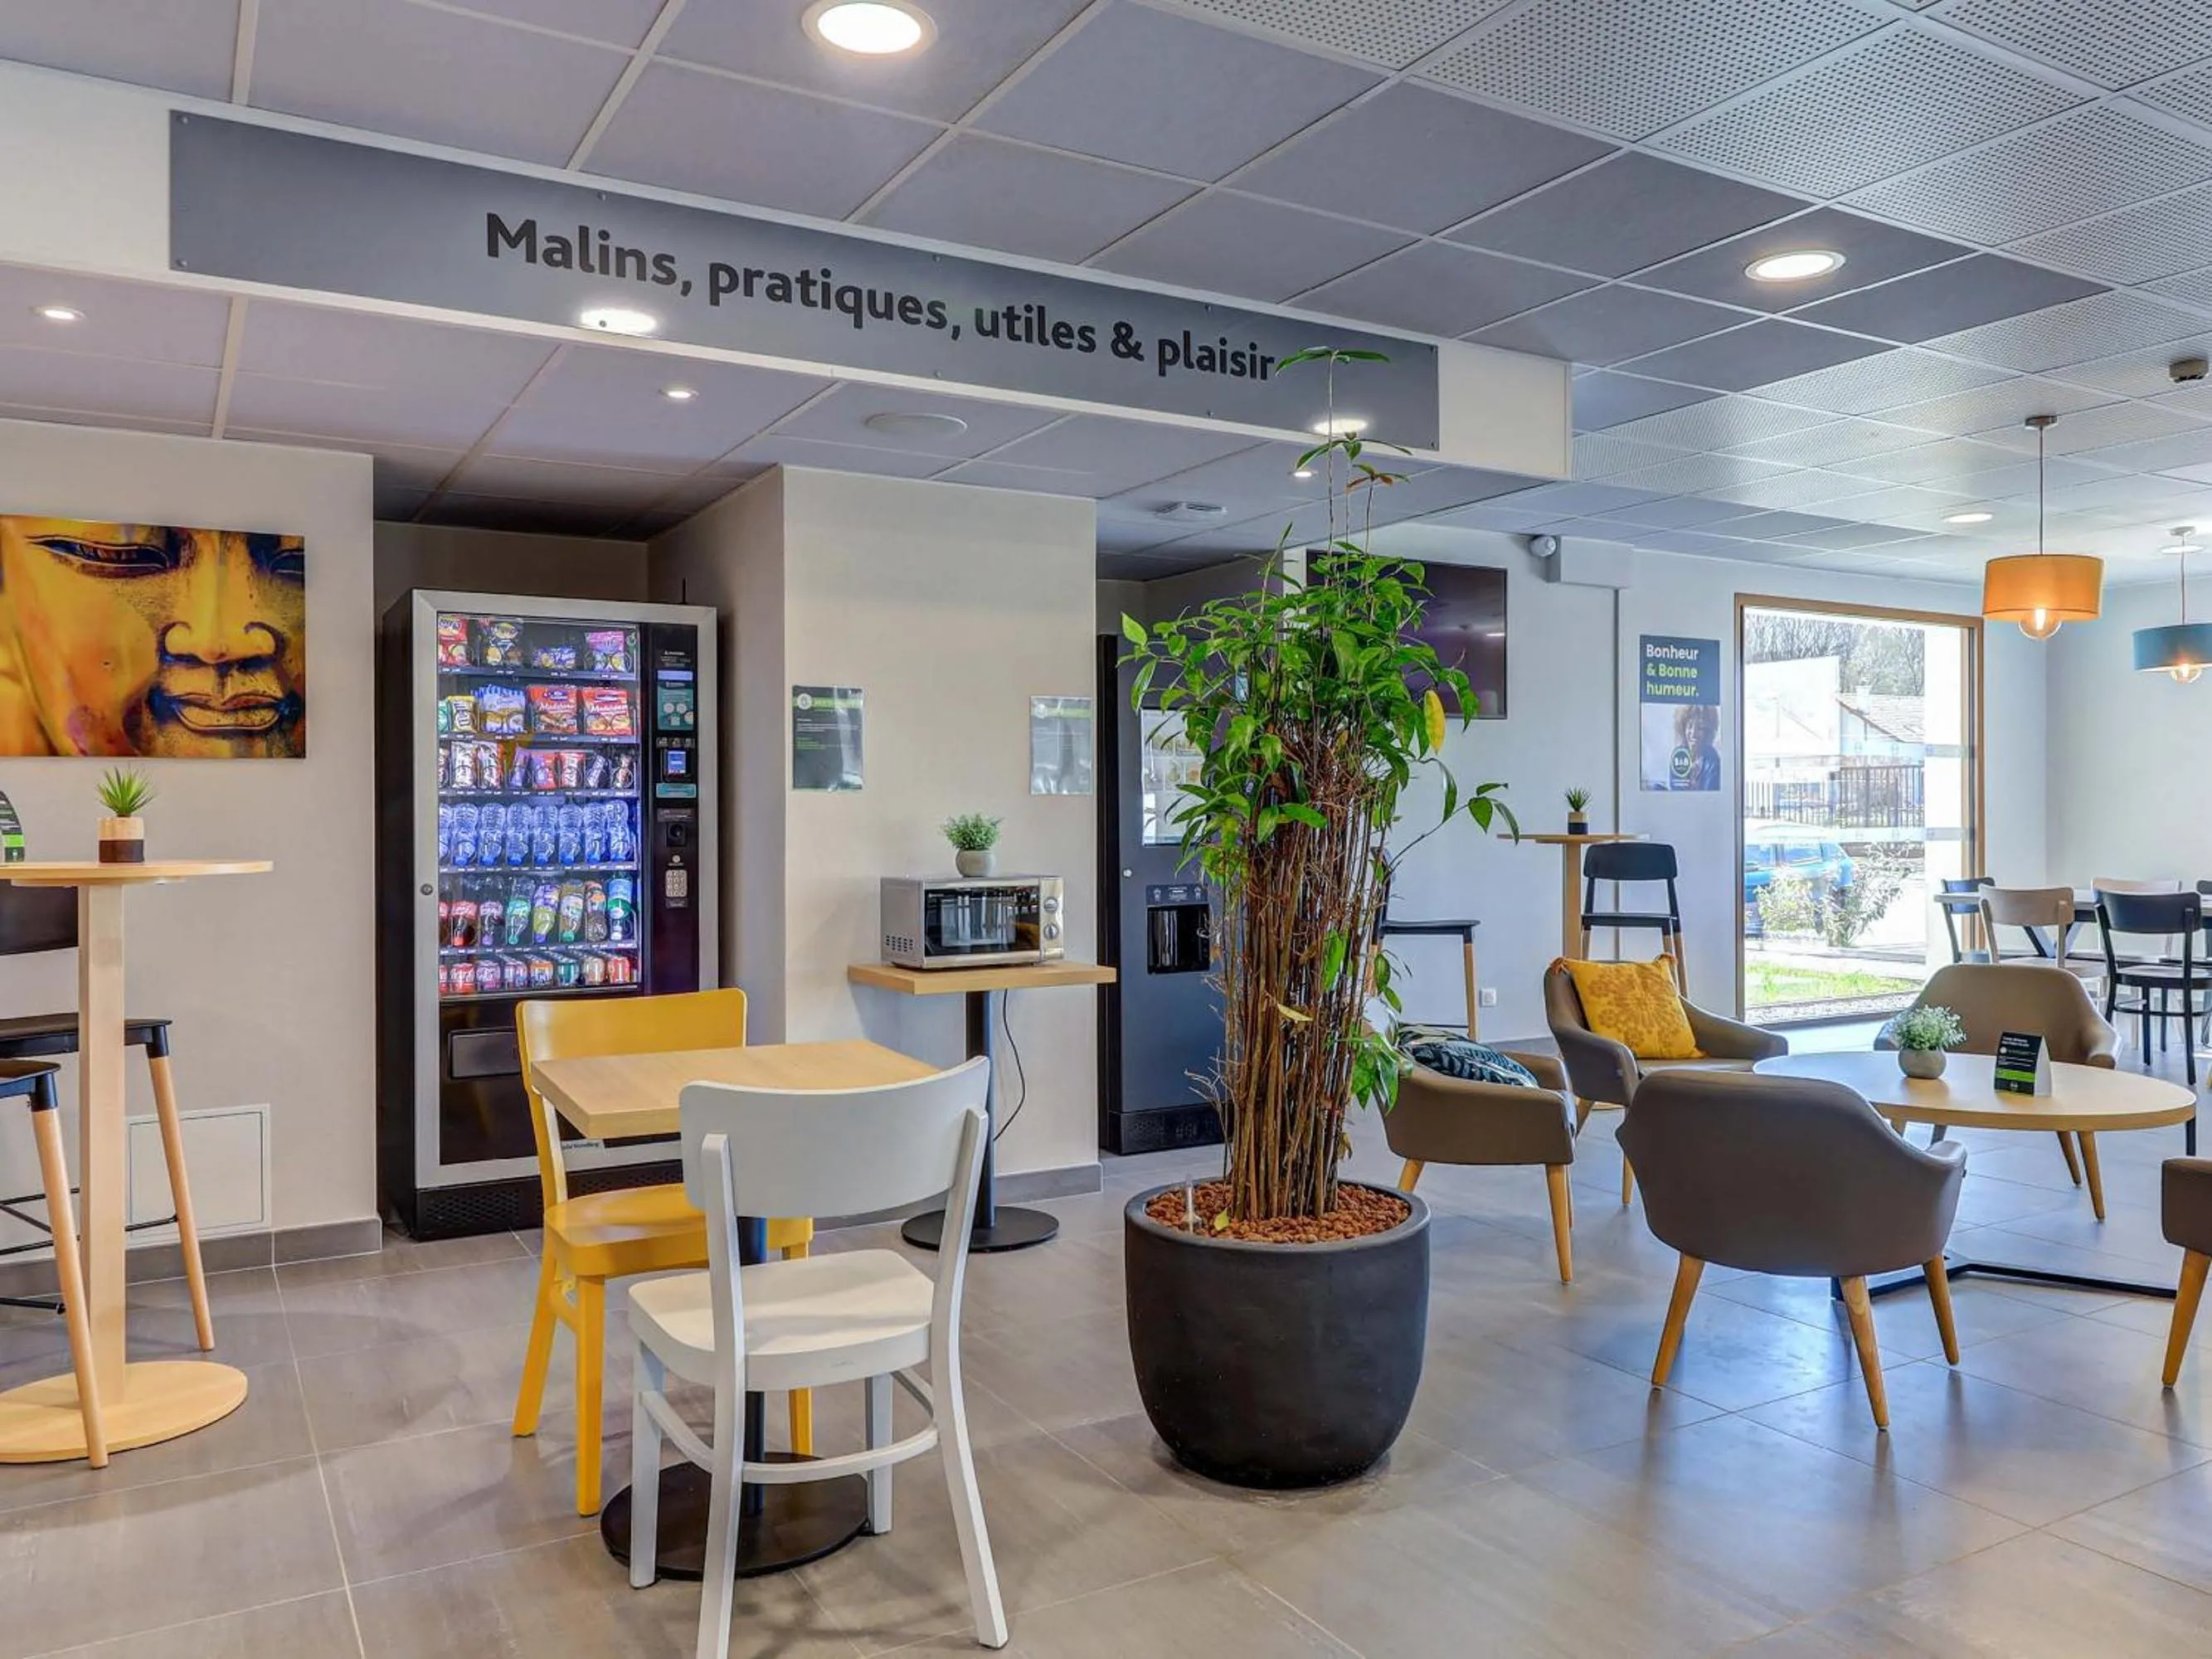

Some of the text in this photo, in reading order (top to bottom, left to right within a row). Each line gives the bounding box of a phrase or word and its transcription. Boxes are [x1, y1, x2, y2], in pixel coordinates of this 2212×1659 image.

[486, 212, 1275, 381] Malins, pratiques, utiles & plaisir
[1646, 644, 1699, 660] Bonheur
[1646, 664, 1699, 679] & Bonne
[1646, 682, 1699, 697] humeur.
